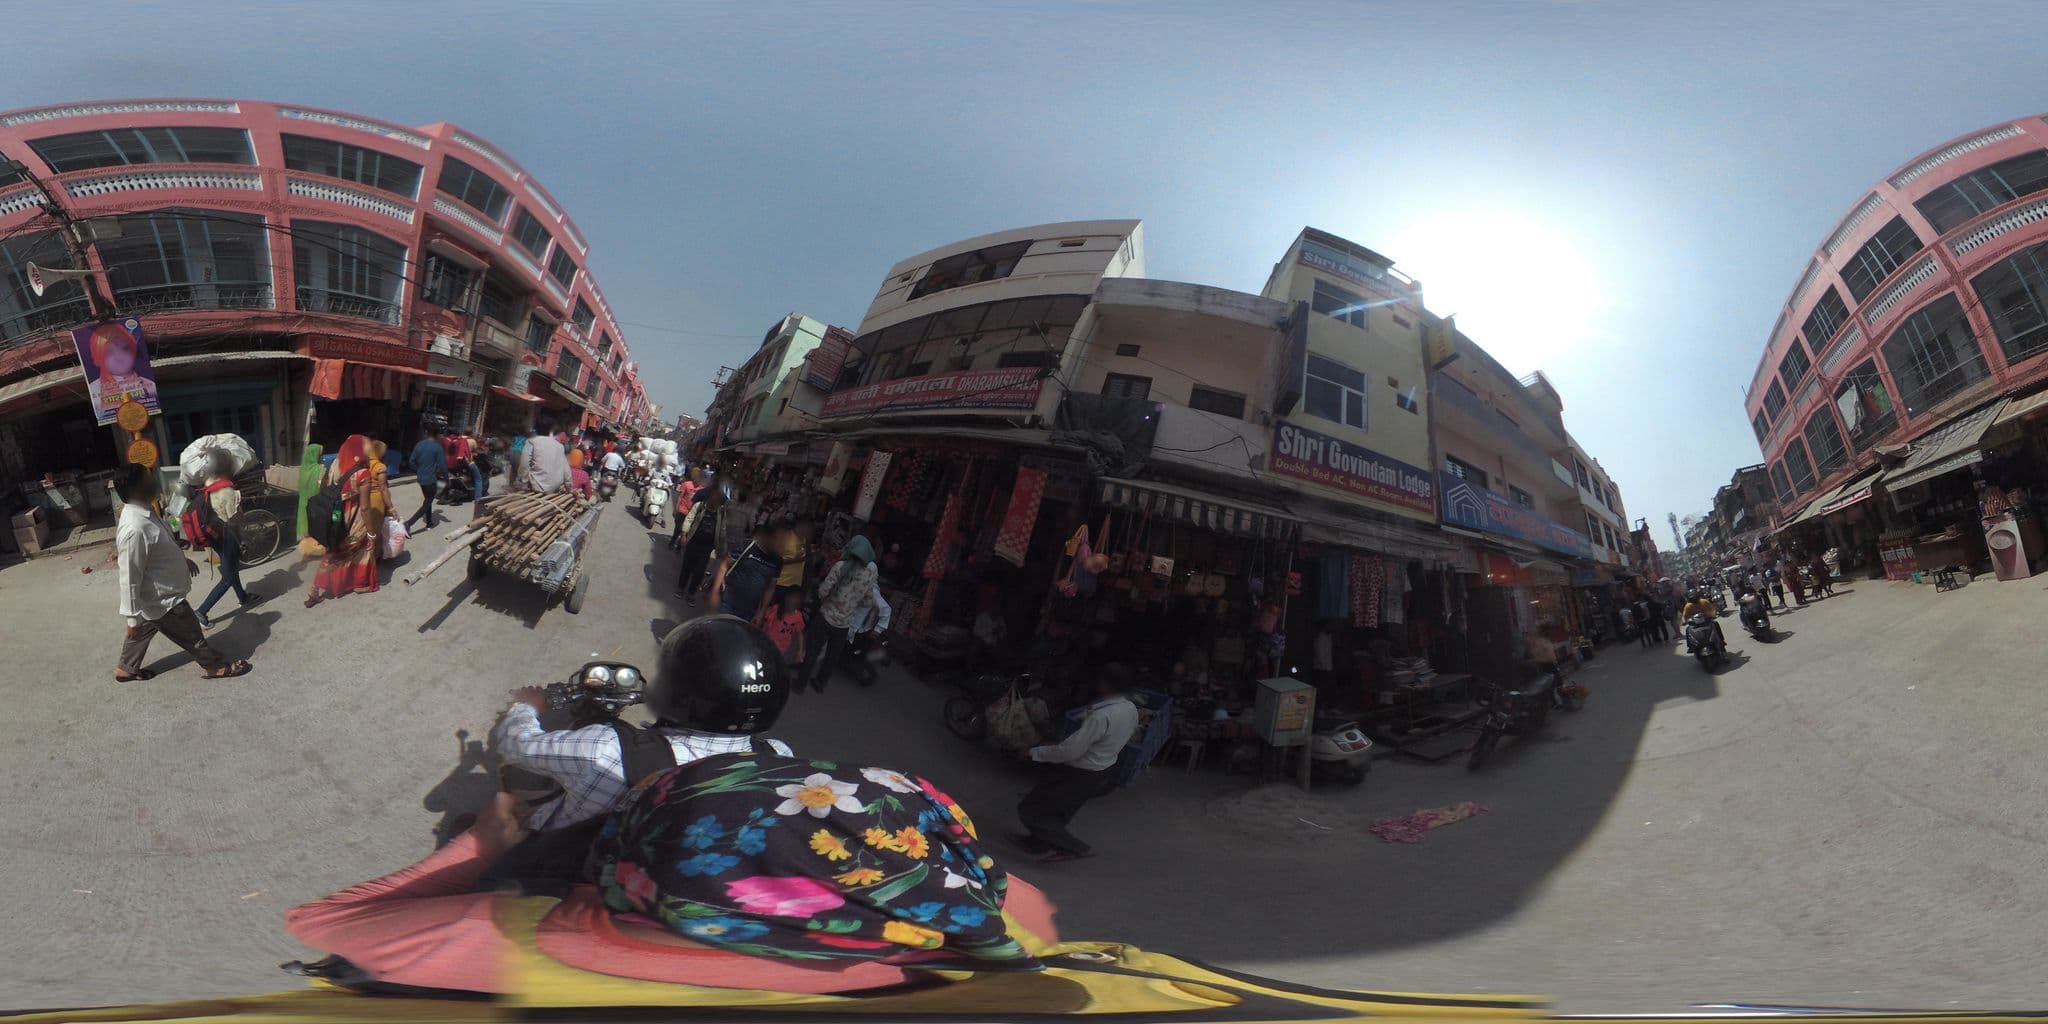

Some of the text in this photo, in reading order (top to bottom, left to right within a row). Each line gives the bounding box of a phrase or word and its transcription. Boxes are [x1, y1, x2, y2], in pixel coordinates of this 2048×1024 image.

[1303, 252, 1338, 269] Shri
[329, 340, 363, 354] GANGA
[957, 374, 1039, 392] DHARAMSHALA
[1275, 457, 1311, 475] Double
[1312, 467, 1330, 481] Bed
[1278, 426, 1432, 498] Shri Govindam Lodge
[741, 683, 772, 693] Hero
